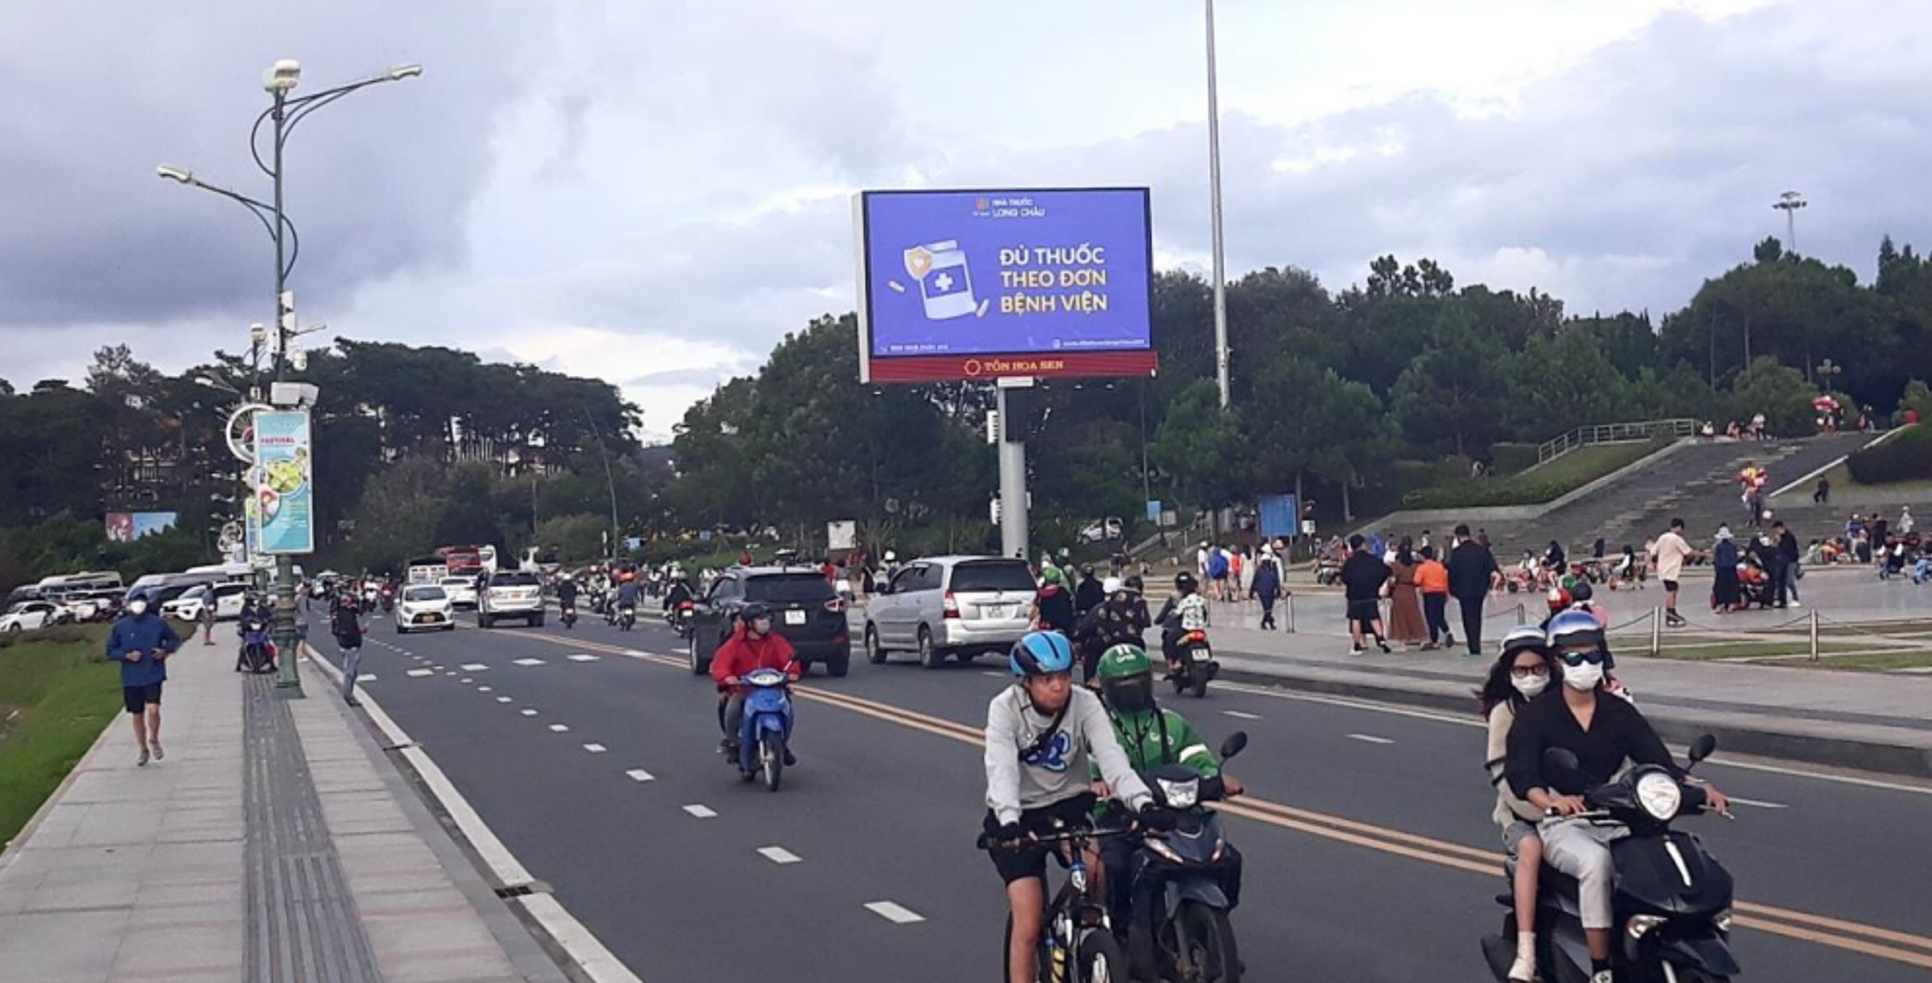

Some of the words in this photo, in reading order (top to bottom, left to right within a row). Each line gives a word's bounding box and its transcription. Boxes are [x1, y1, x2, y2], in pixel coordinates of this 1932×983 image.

[992, 208, 1018, 217] LONG
[1000, 244, 1029, 266] ĐỦ
[1034, 242, 1105, 265] THUỐC
[1000, 270, 1055, 288] THEO
[1059, 268, 1106, 287] ĐƠN
[1001, 291, 1056, 317] BỆNH
[1060, 290, 1108, 315] VIỆN
[984, 358, 1010, 371] TÔN
[1012, 361, 1038, 371] HOA
[1040, 360, 1064, 370] SEN
